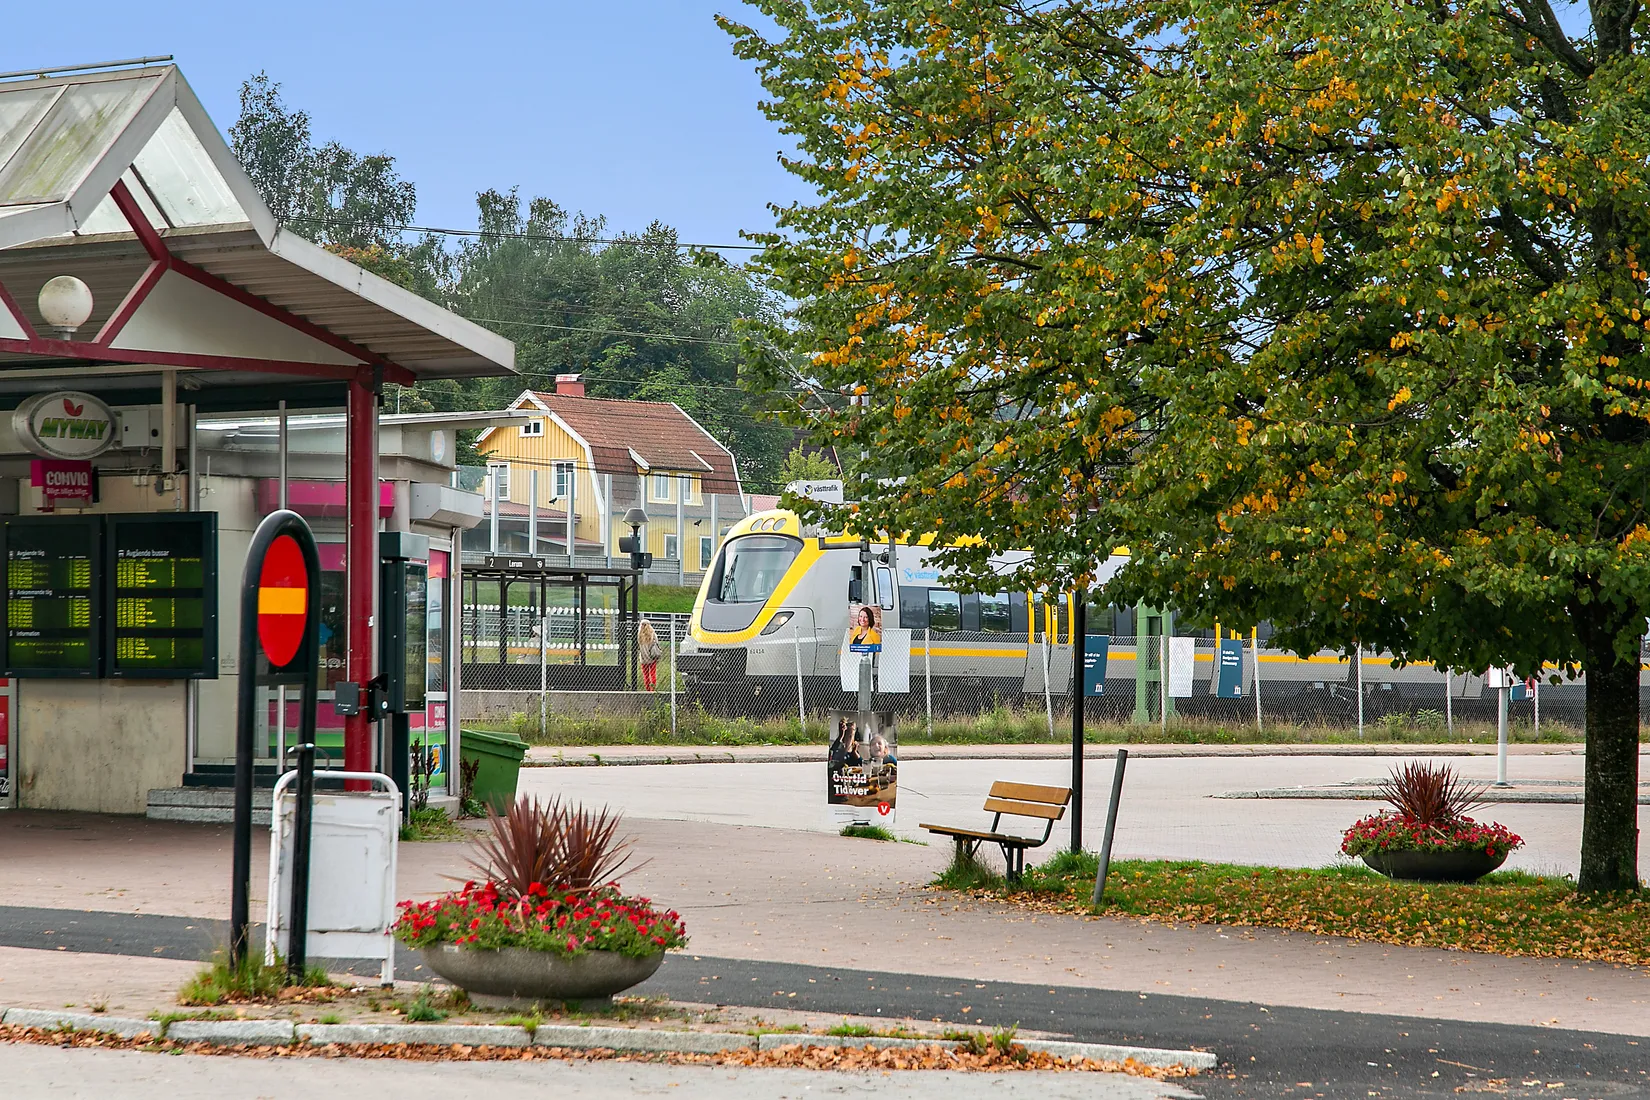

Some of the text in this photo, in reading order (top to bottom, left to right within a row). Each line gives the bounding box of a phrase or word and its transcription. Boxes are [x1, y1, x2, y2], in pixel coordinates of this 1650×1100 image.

[39, 417, 109, 440] MYWAY
[46, 470, 89, 486] COMVIQ
[813, 484, 839, 492] västtrafik
[489, 558, 494, 568] 2
[508, 559, 523, 567] Lerum
[833, 771, 867, 784] Övertid
